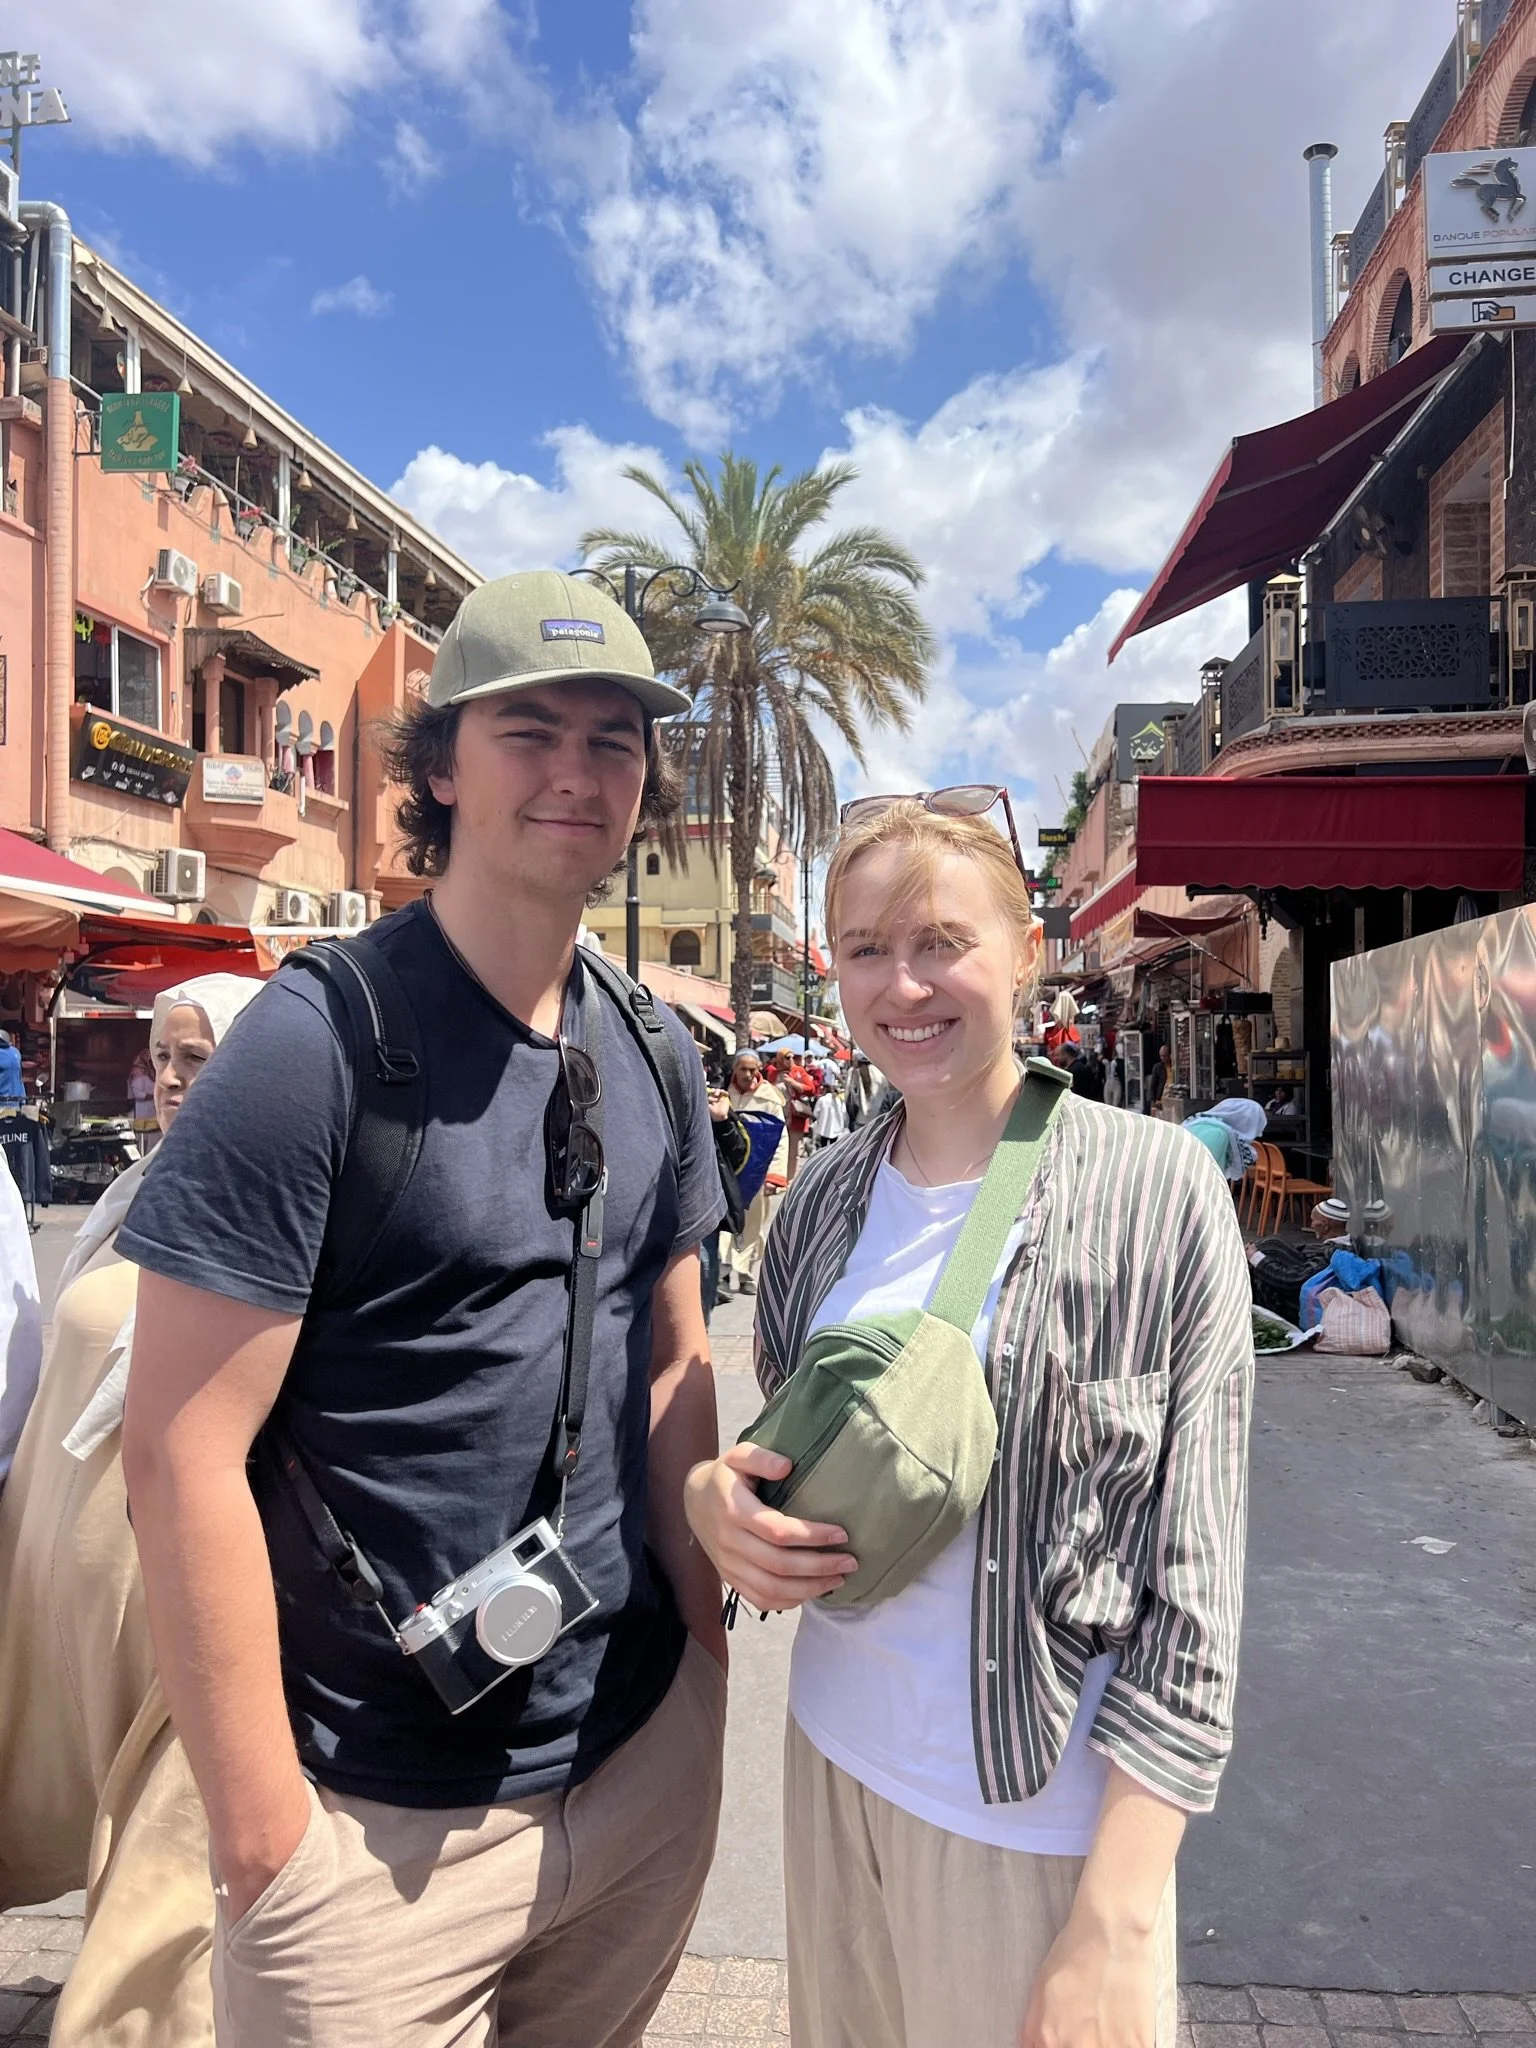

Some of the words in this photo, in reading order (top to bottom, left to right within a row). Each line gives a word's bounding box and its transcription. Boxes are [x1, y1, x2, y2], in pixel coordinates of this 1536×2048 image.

[1433, 231, 1480, 241] BANQUE
[1449, 267, 1536, 286] CHANGE
[552, 627, 599, 638] patagonia
[1040, 833, 1067, 843] Sushi
